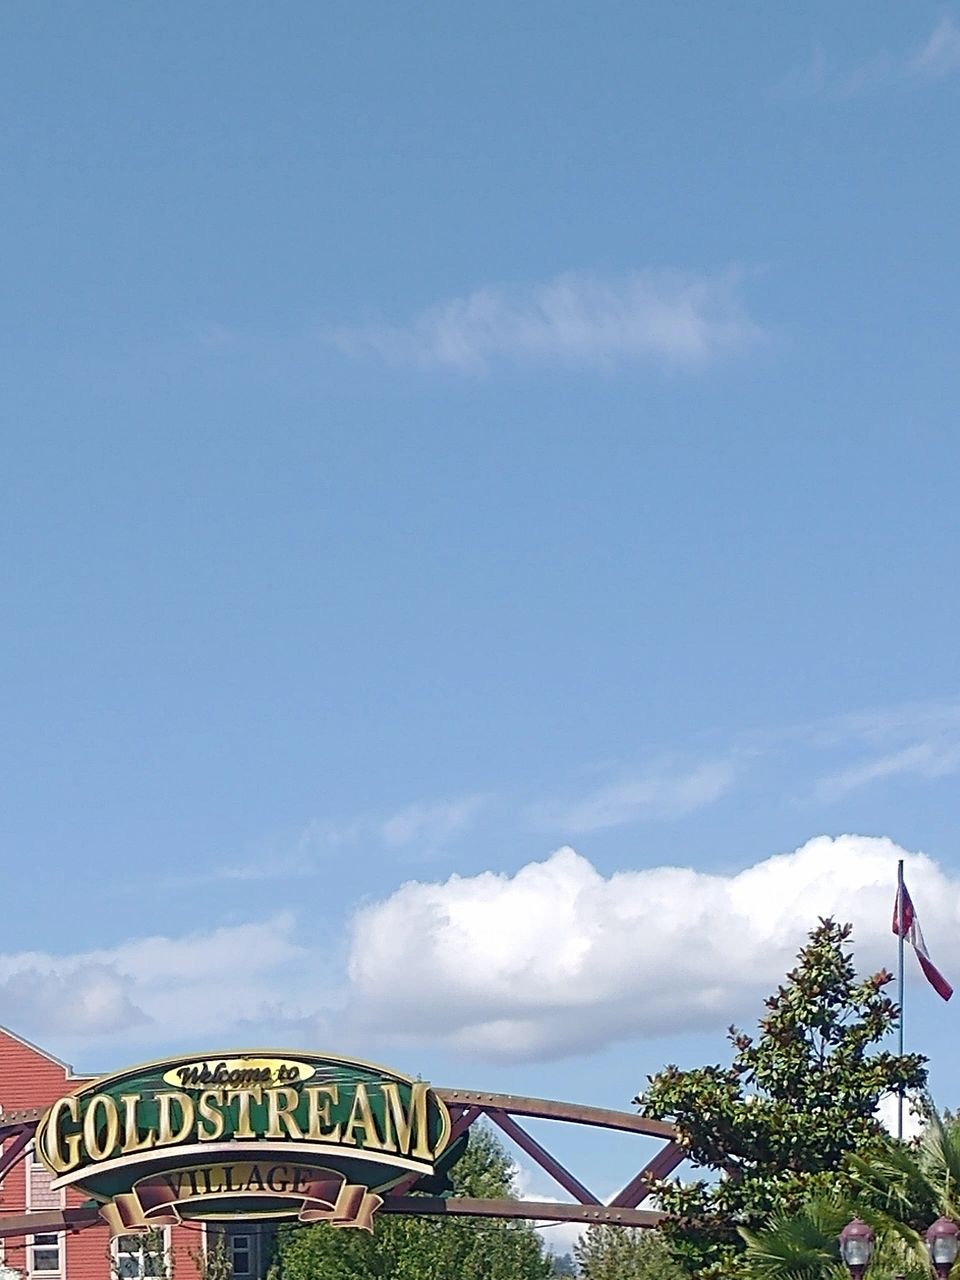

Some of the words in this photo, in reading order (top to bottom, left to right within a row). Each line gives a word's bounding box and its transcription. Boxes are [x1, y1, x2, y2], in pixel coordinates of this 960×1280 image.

[177, 1062, 271, 1086] Welcome
[273, 1064, 299, 1081] to
[47, 1083, 439, 1171] GOLDSTREAM
[162, 1165, 313, 1199] VILLAGE
